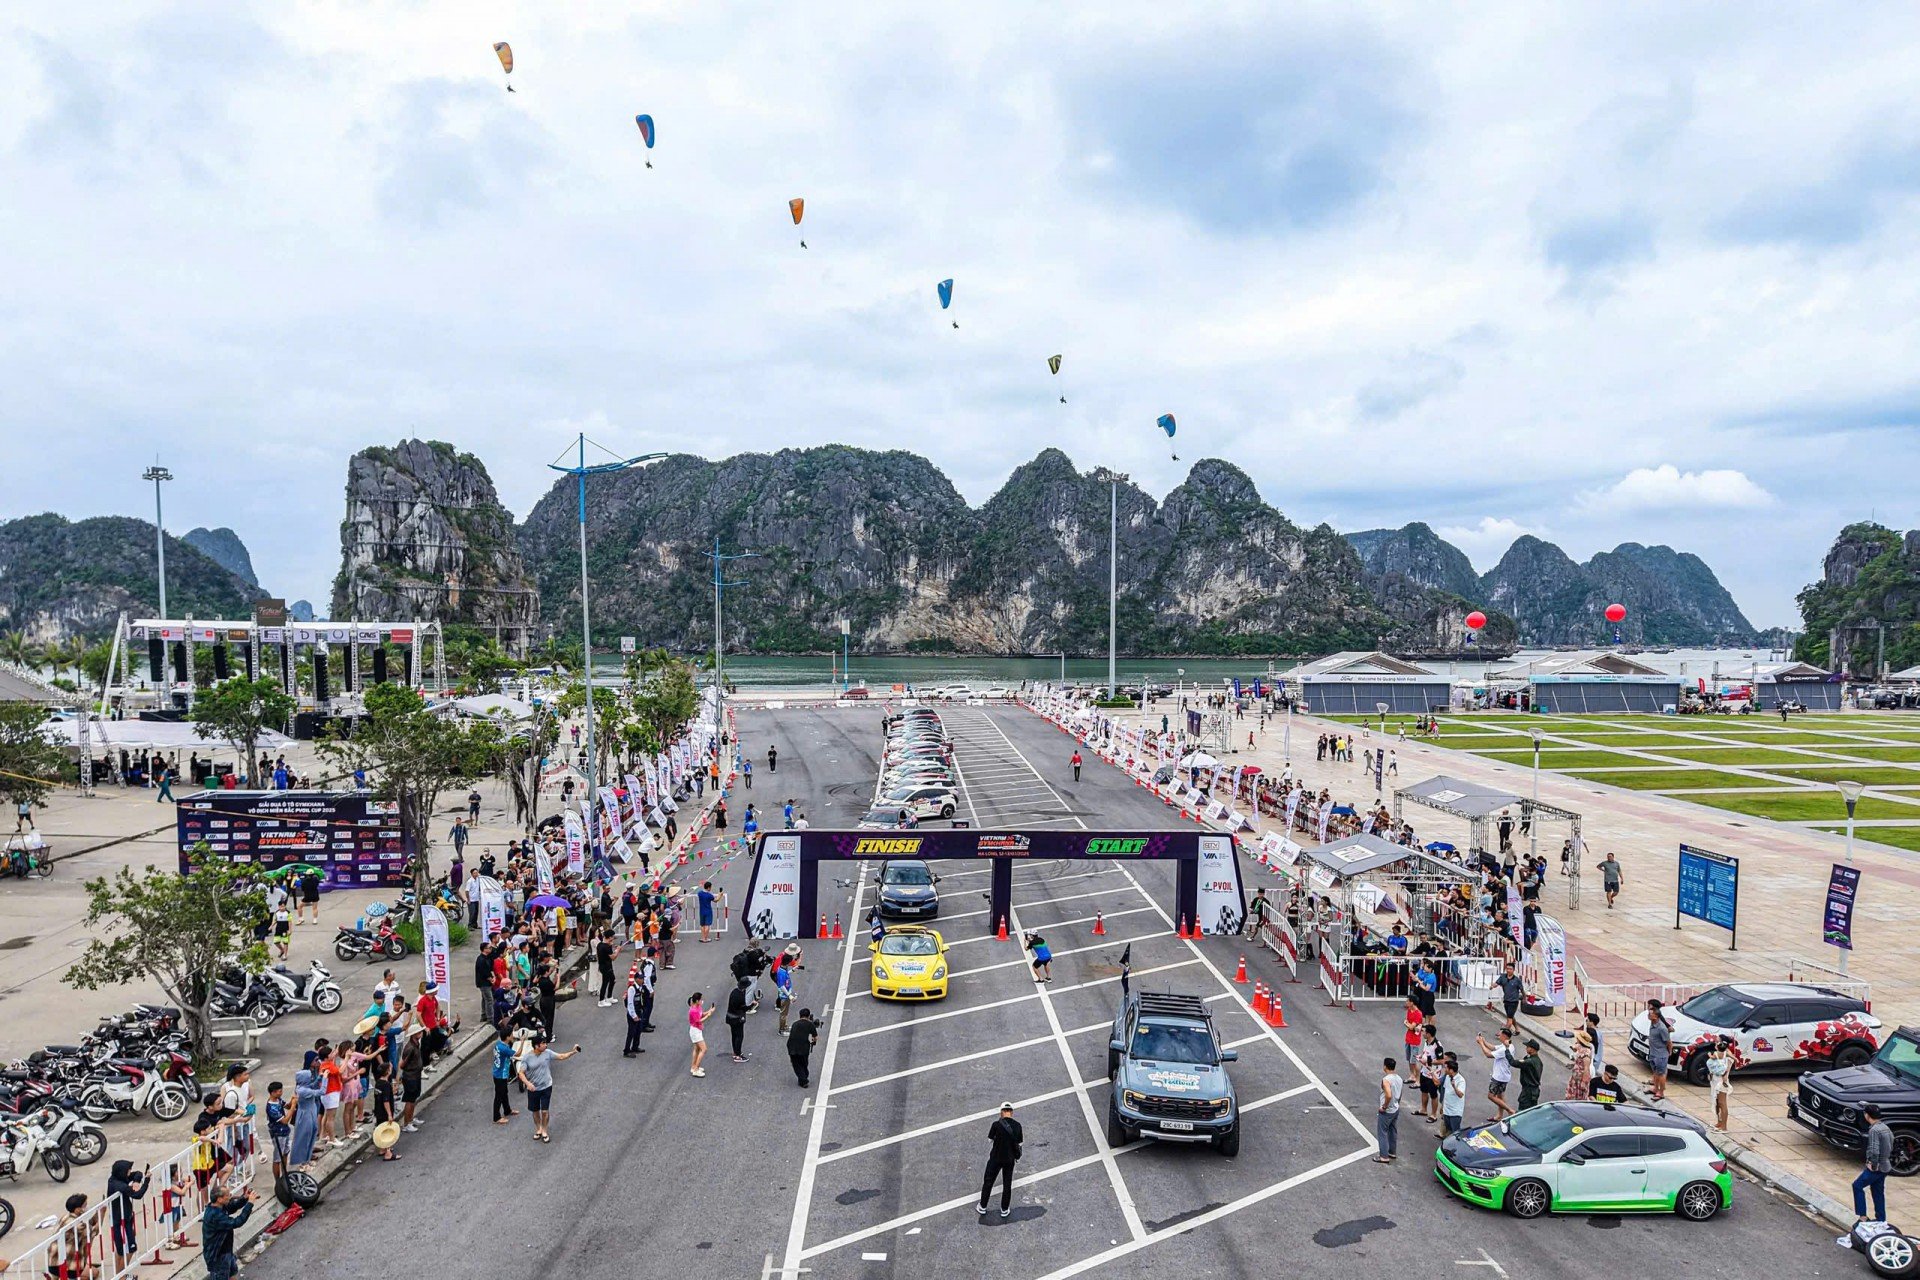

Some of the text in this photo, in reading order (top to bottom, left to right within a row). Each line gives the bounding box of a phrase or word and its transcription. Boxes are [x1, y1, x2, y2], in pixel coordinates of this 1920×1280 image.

[571, 841, 581, 863] PVOIL
[855, 839, 922, 853] FINISH
[1087, 839, 1147, 853] START
[773, 883, 794, 892] PVOIL
[1213, 881, 1232, 890] PVOIL
[433, 953, 447, 985] PVOIL
[1552, 961, 1564, 993] PVOIL
